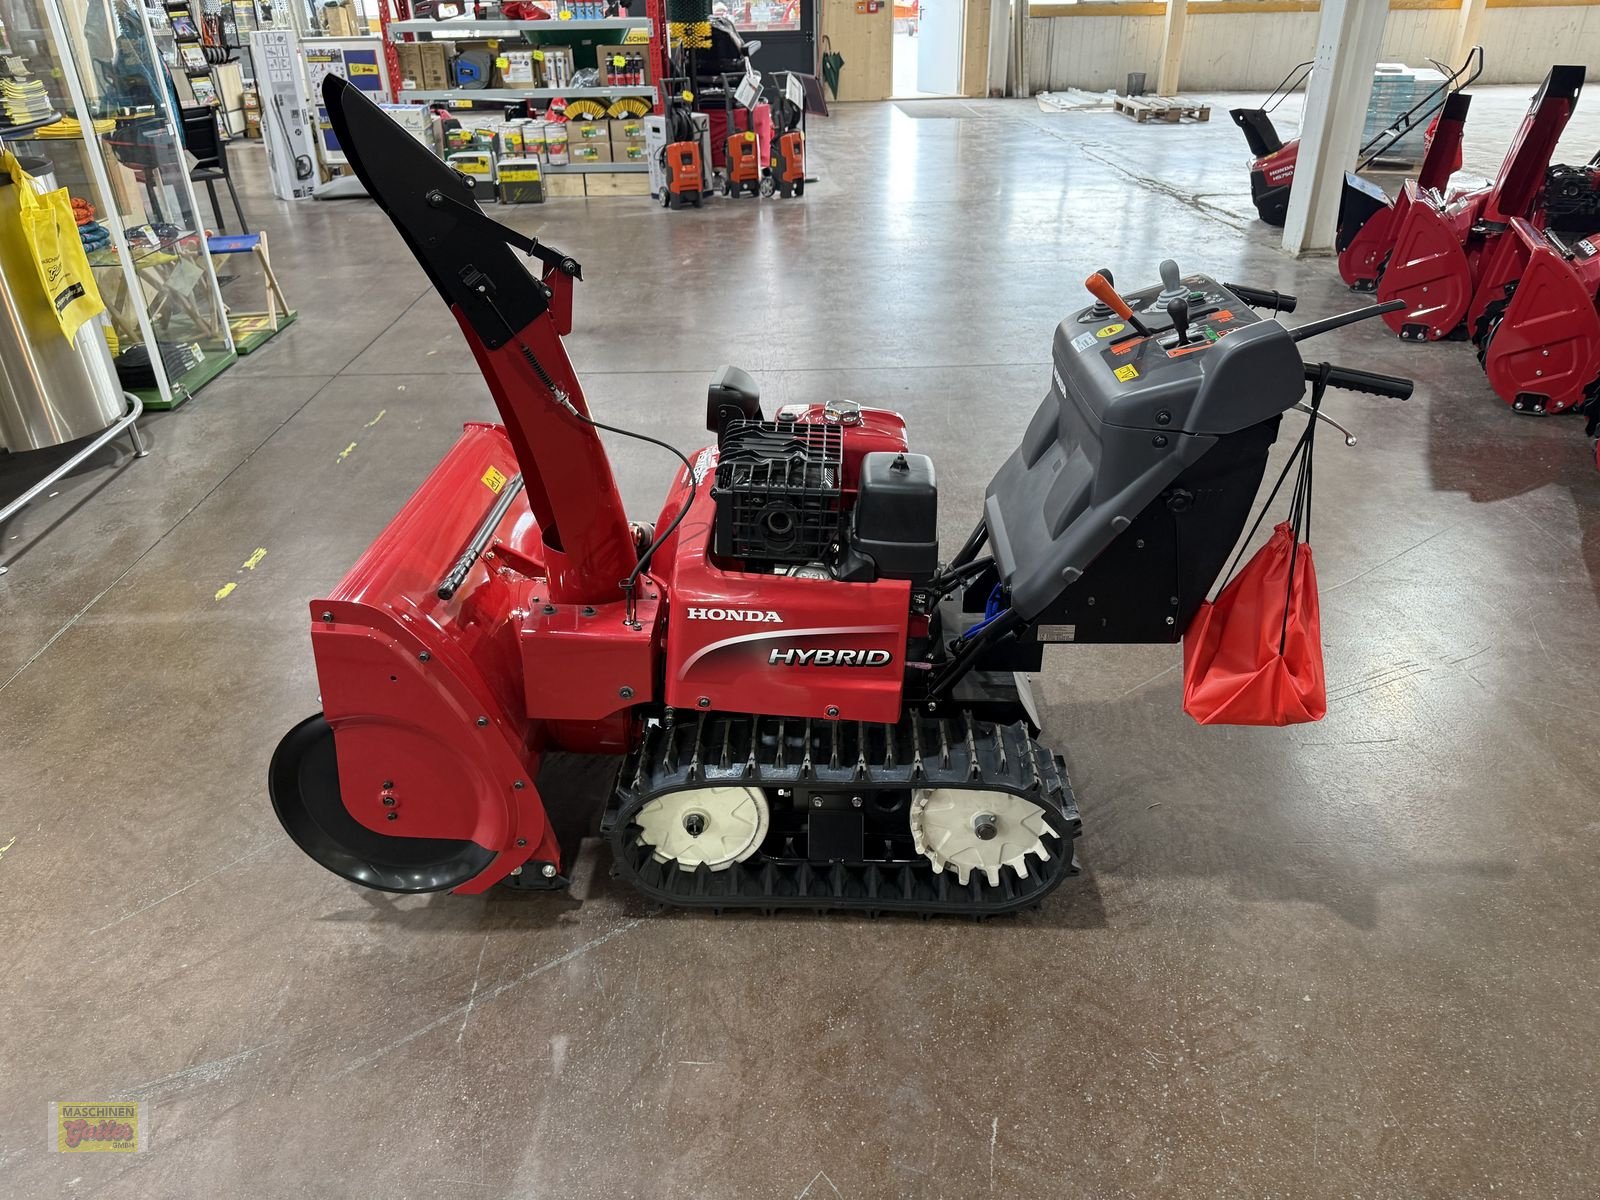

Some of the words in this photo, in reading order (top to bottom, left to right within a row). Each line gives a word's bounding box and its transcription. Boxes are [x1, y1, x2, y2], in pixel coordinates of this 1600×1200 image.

[1269, 165, 1294, 176] HONDA
[687, 608, 784, 623] HONDA
[768, 649, 892, 666] HYBRID
